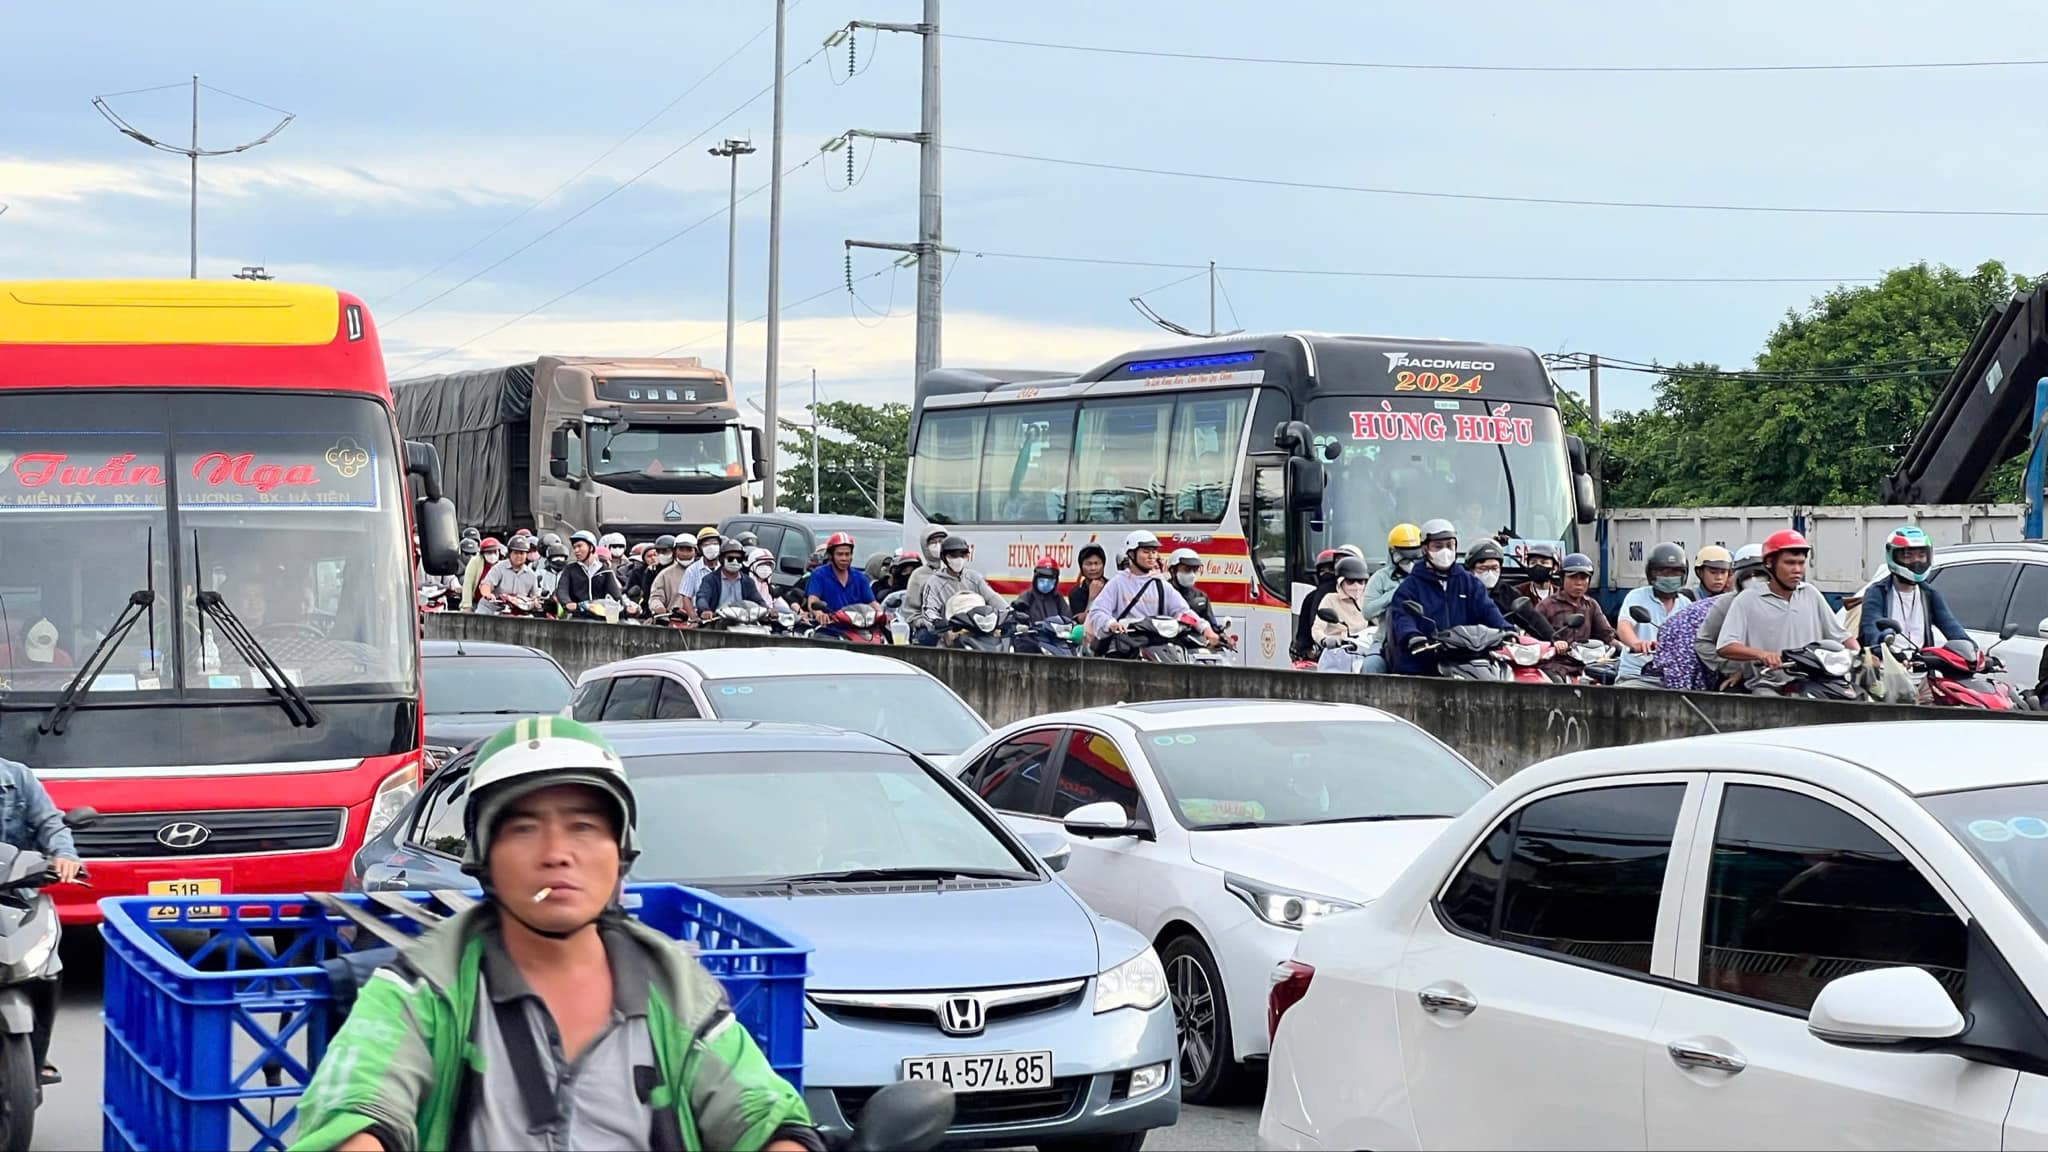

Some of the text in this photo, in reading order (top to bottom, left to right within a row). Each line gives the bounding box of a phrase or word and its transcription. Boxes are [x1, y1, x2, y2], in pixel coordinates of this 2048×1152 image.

[1382, 352, 1495, 374] TRACOMECO
[1395, 371, 1482, 393] 2024
[1349, 400, 1533, 446] HÙNG HIẾU
[12, 451, 320, 493] Tuấn Nga
[1008, 534, 1040, 568] HÙNG
[1045, 532, 1074, 568] HIẾU
[1629, 541, 1643, 562] 50H
[1224, 561, 1243, 575] 2024
[909, 1055, 1044, 1088] 51A-574.85
